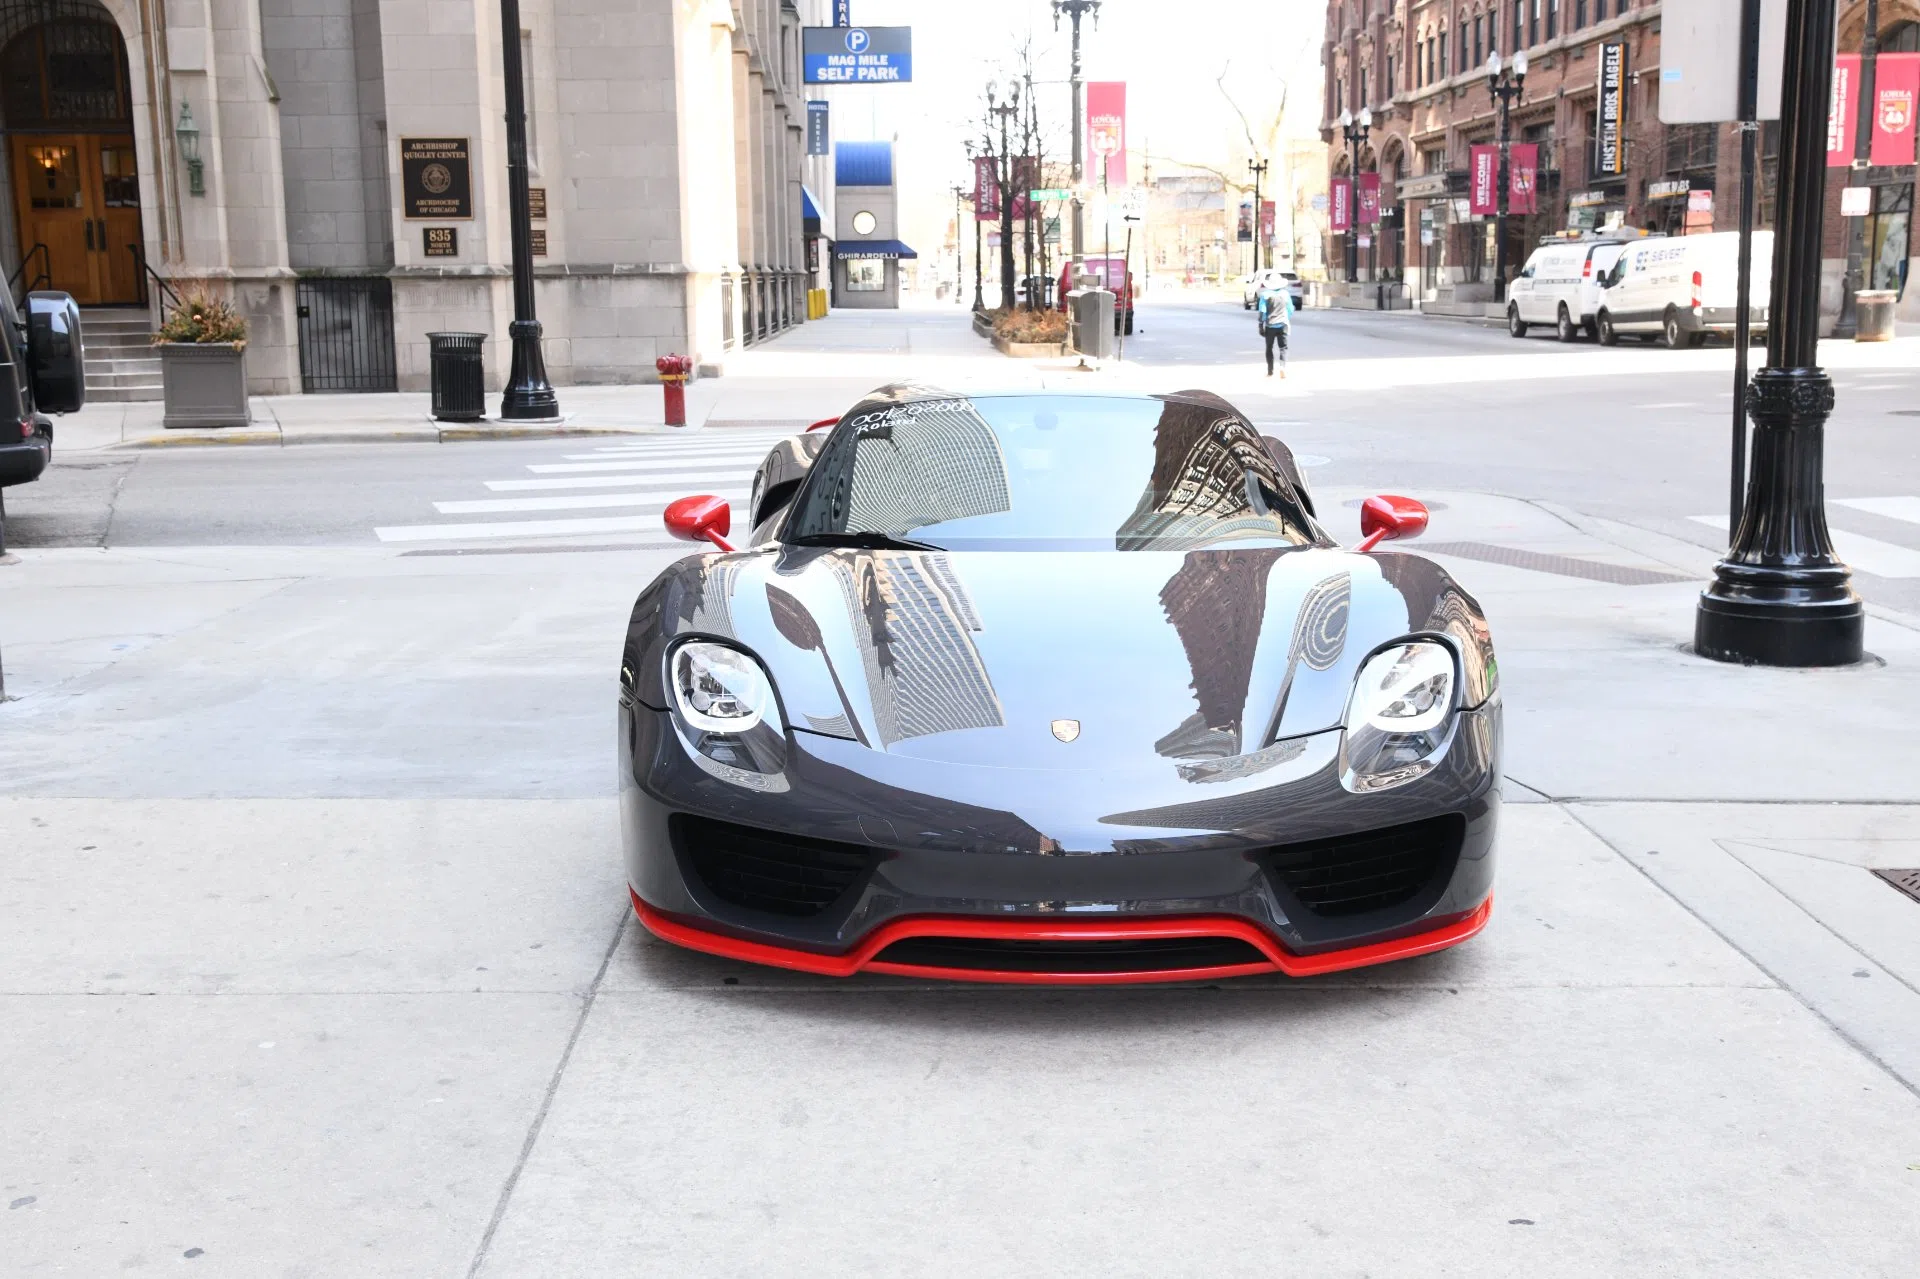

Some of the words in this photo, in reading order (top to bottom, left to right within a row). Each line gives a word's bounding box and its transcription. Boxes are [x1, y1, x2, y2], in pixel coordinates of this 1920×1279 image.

[851, 32, 865, 50] P
[828, 55, 856, 66] MAG
[859, 55, 888, 66] MILE
[1606, 45, 1620, 88] BAGELS
[817, 67, 854, 80] SELF
[858, 67, 899, 80] PARK
[1602, 122, 1616, 172] EINSTEIN
[404, 152, 436, 160] QUIGLEY
[1477, 154, 1486, 206] WELCOME
[429, 230, 451, 241] 835
[838, 252, 899, 260] GHIRARDELLI
